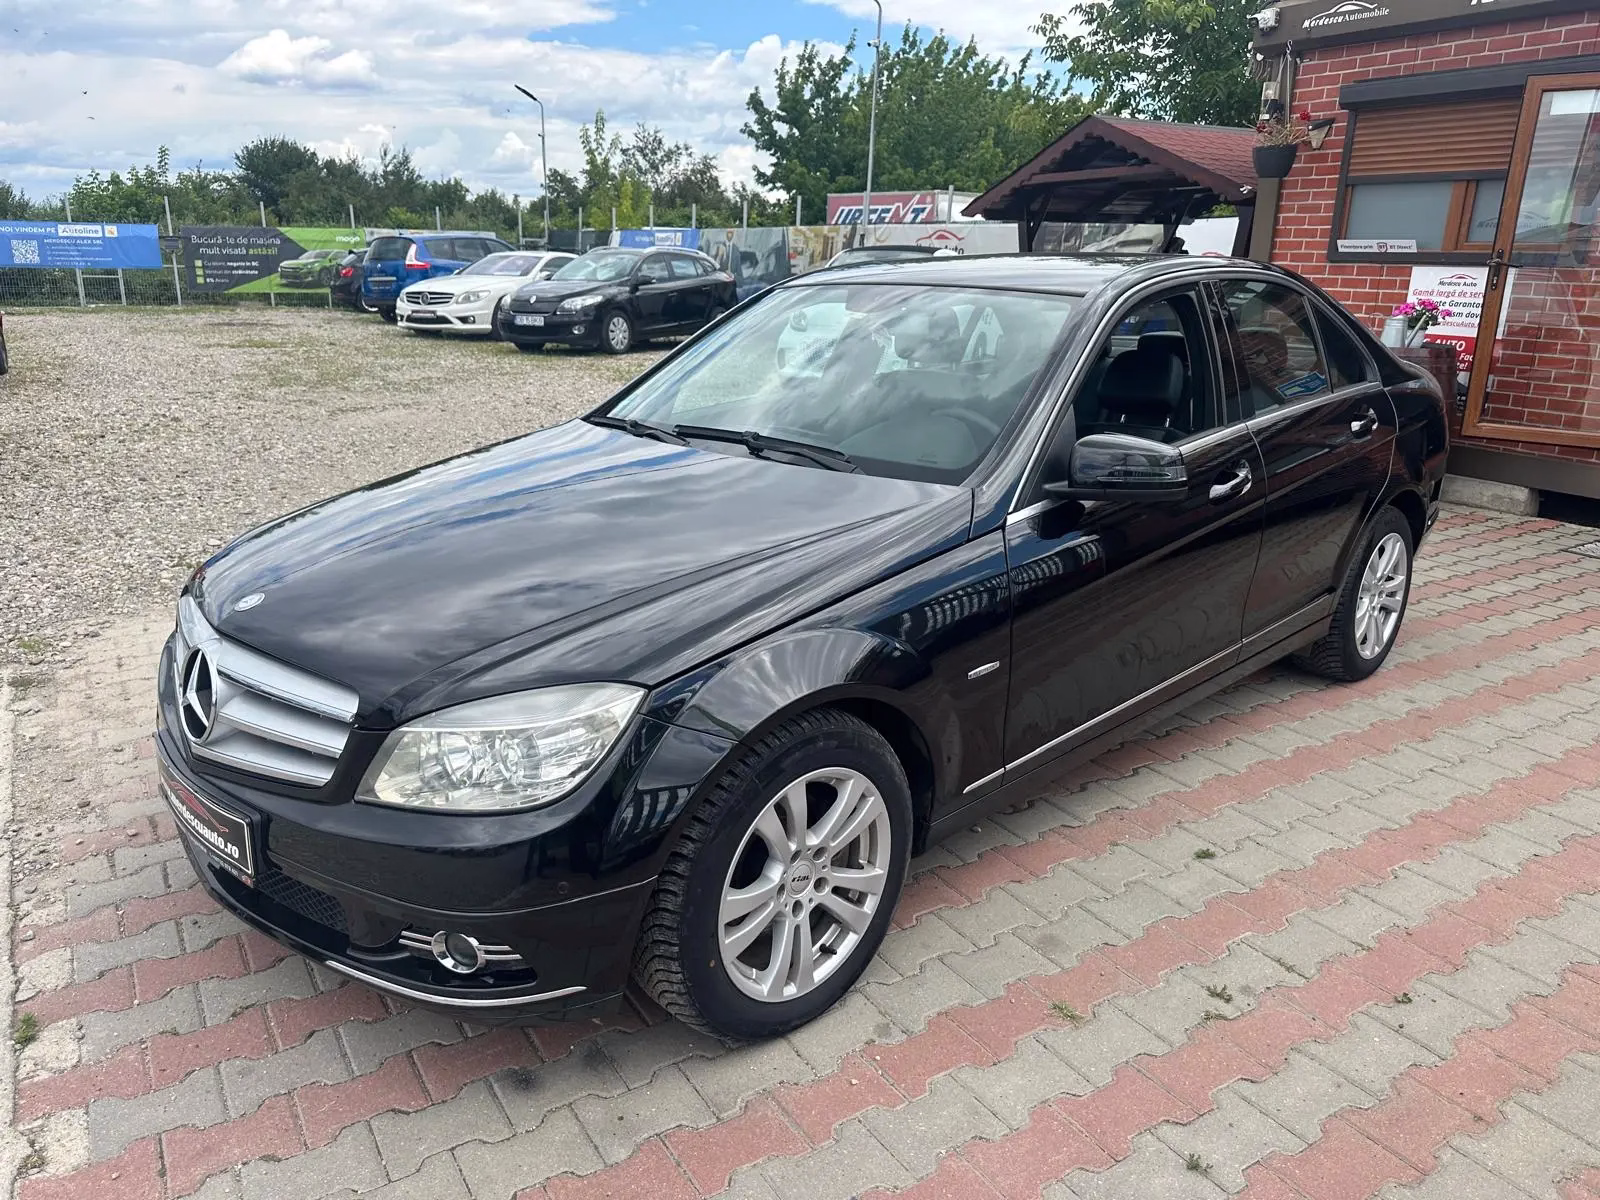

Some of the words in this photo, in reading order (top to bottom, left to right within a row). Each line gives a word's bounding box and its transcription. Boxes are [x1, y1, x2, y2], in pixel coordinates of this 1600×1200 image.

[61, 227, 100, 235] Autoline
[191, 234, 235, 244] Bucură-te
[236, 236, 248, 244] de
[199, 247, 221, 255] mult
[221, 247, 247, 256] visată
[1412, 288, 1435, 297] Gamă
[1435, 289, 1457, 298] largă
[1458, 289, 1469, 297] de
